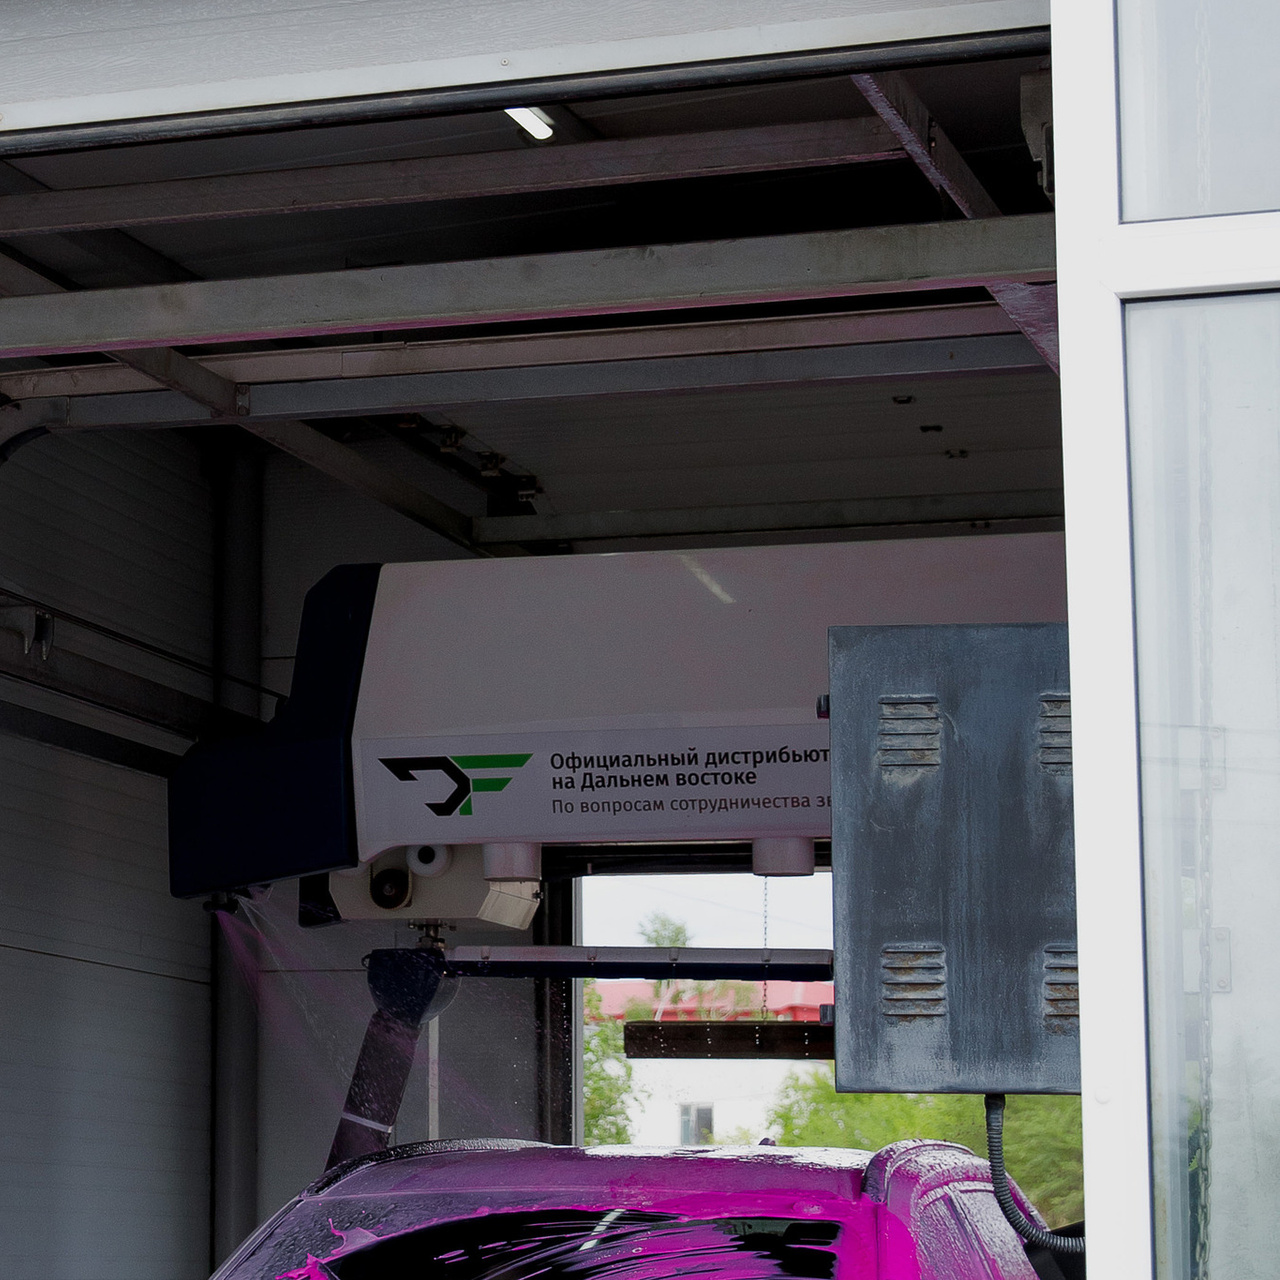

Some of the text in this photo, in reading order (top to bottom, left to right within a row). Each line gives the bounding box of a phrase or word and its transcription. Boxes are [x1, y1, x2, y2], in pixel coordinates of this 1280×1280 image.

[550, 746, 699, 774] Официальный
[552, 770, 757, 792] на Дальнем востоке
[552, 799, 574, 814] По
[580, 799, 665, 816] вопросам
[670, 795, 811, 814] сотрудничества
